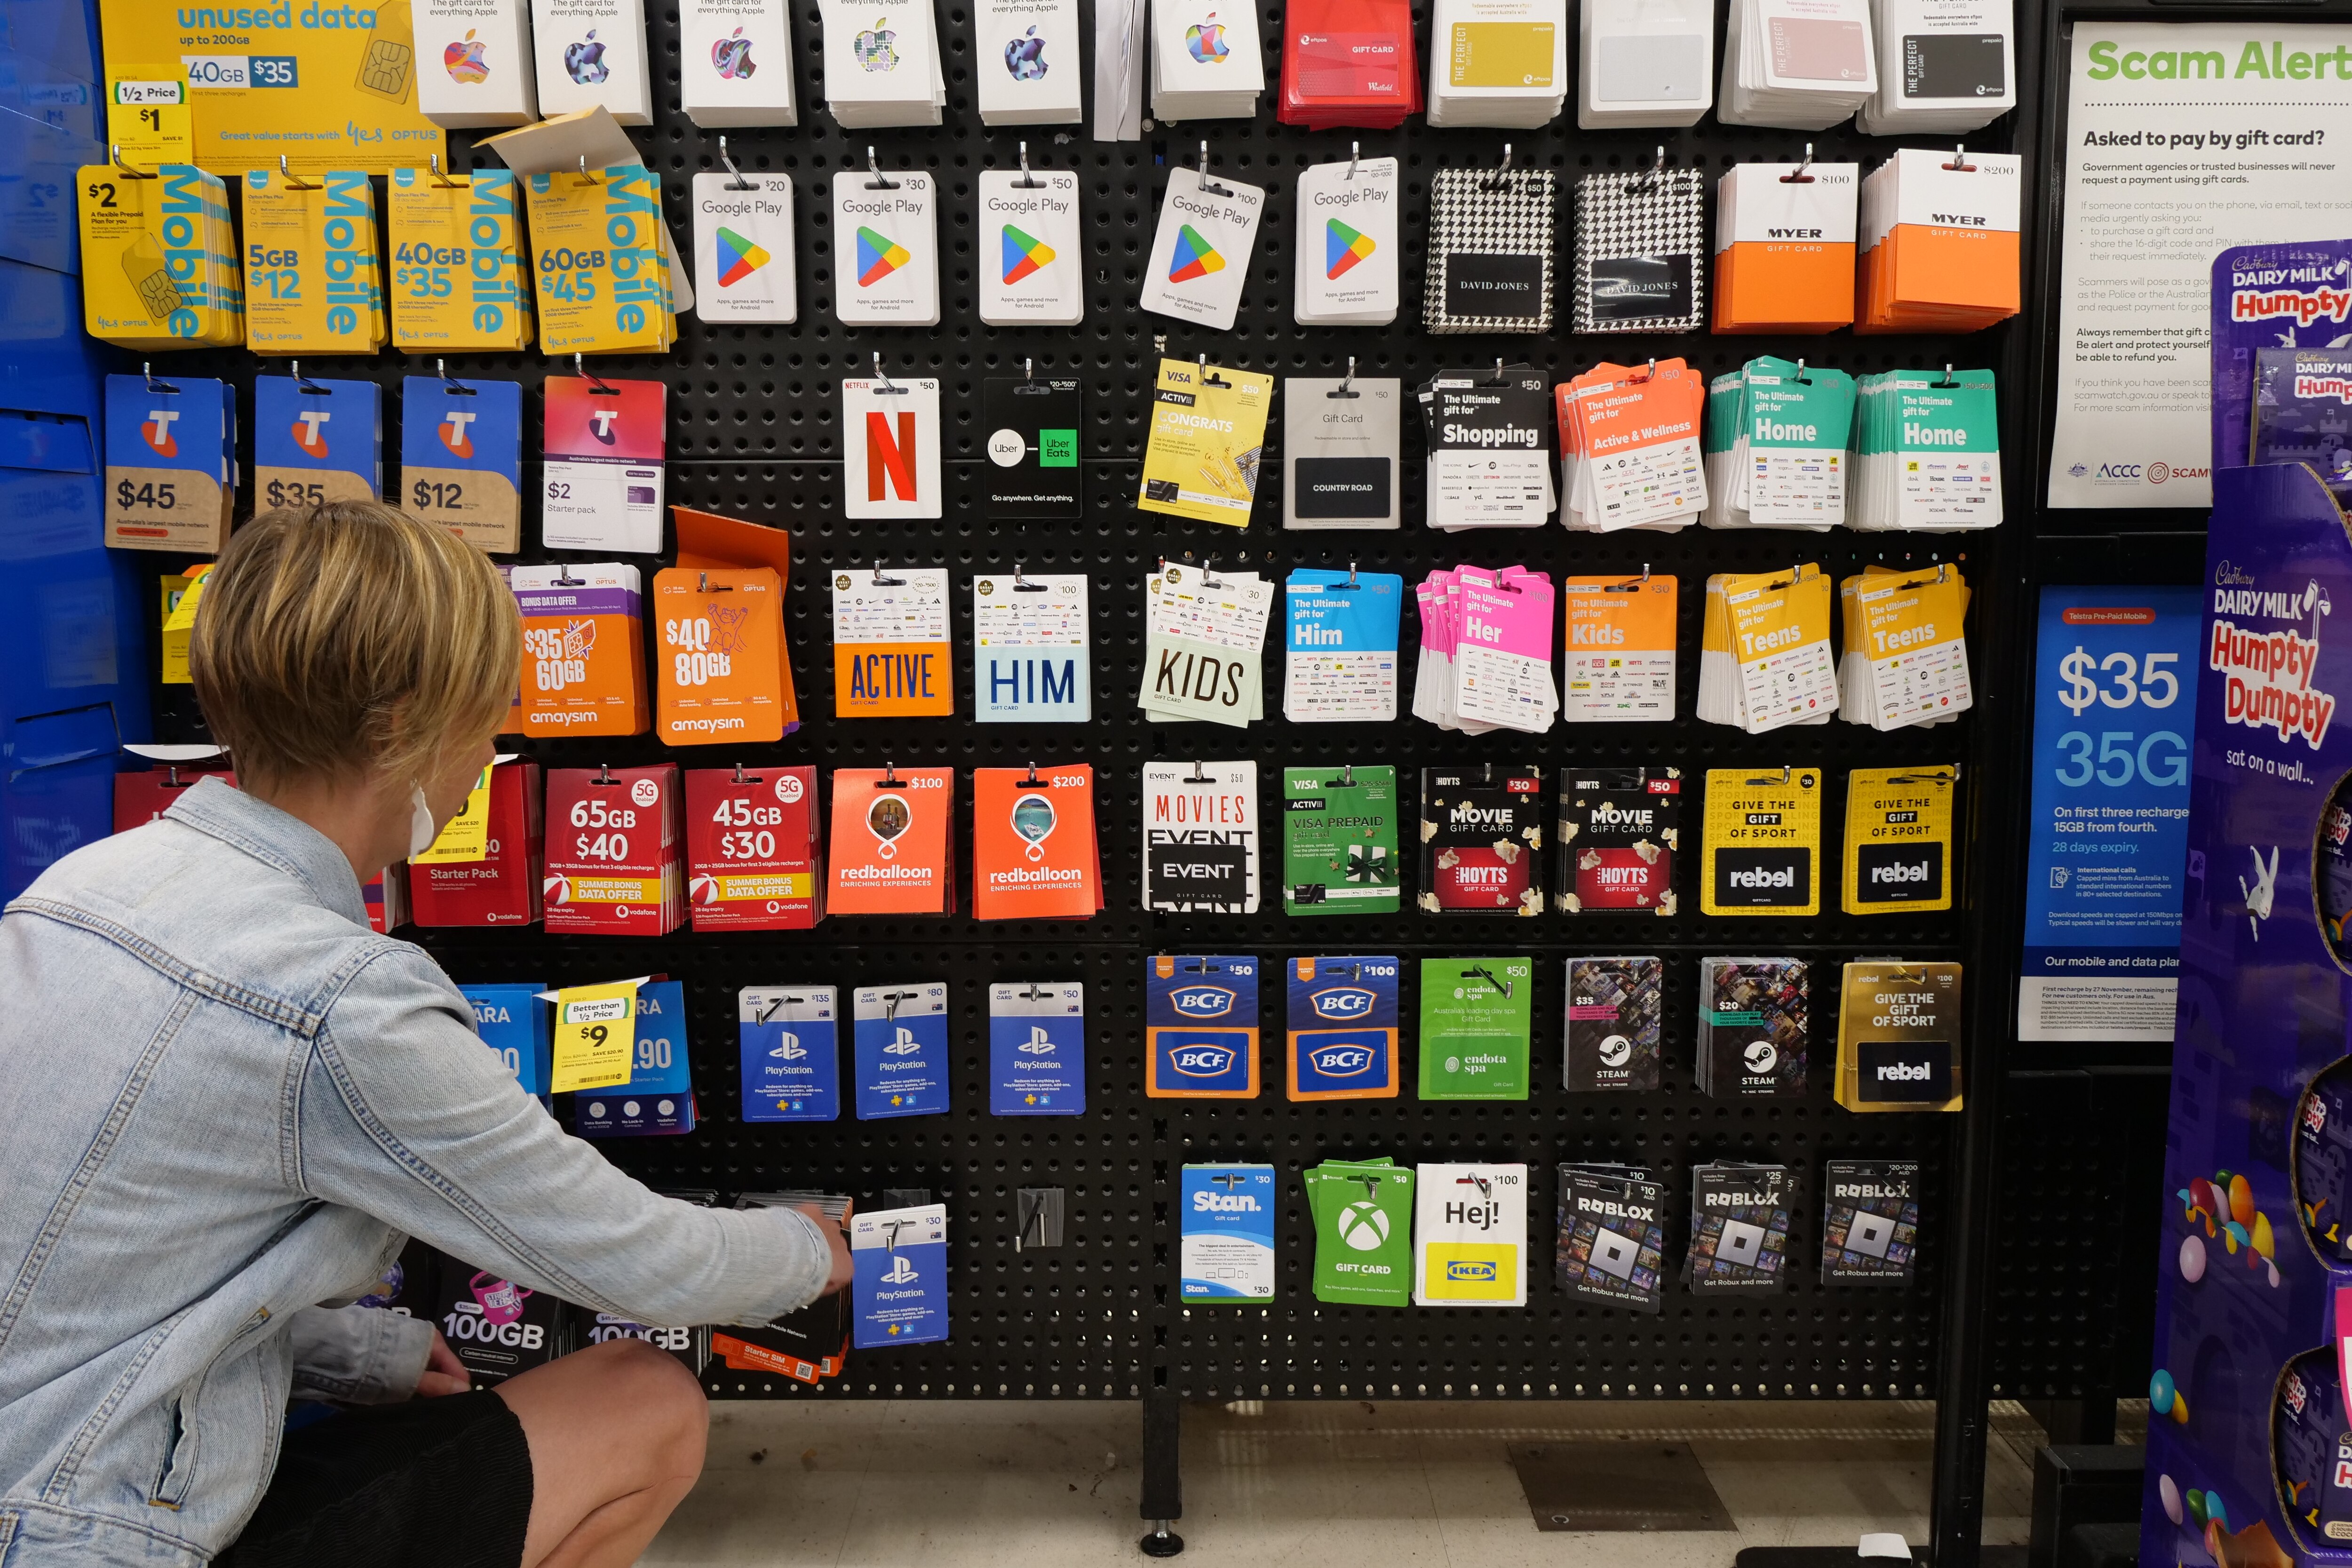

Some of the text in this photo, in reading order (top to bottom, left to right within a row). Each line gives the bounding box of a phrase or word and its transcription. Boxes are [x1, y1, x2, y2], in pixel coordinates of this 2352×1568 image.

[177, 0, 377, 29] unused data
[430, 7, 498, 17] everything Apple
[180, 35, 250, 46] up to 200GB
[1907, 40, 1918, 93] THE PERFECT
[2087, 41, 2352, 80] Scam Alert
[189, 61, 293, 83] 40GB $35
[147, 87, 175, 98] Price
[1367, 82, 1392, 92] Westfield
[140, 109, 160, 132] $1
[2084, 130, 2324, 150] Asked to pay by gift card?
[2145, 163, 2187, 173] agencies
[765, 181, 785, 191] $20
[1822, 175, 1849, 184] $100
[2082, 176, 2118, 185] request
[2129, 176, 2172, 185] payment
[2174, 176, 2200, 185] using
[2202, 175, 2218, 185] gift
[88, 183, 117, 208] $2
[702, 200, 782, 217] Google Play
[1768, 229, 1822, 238] MYER
[159, 166, 208, 339] Mobile
[249, 244, 298, 268] 5GB
[540, 250, 605, 272] 60GB
[250, 270, 300, 299] $12
[541, 272, 596, 302] $45
[1460, 281, 1529, 291] DAVID JONES
[2233, 268, 2335, 287] DAIRY MILK
[2236, 290, 2351, 322] Humpty
[1444, 395, 1500, 404] The Ultimate
[1444, 406, 1474, 416] gift for
[1443, 424, 1538, 447] Shopping
[1756, 418, 1816, 442] Home
[1046, 439, 1069, 448] Uber
[117, 478, 175, 511] $45
[548, 504, 596, 515] Starter pack
[2215, 589, 2303, 620] DAIRY MILK
[667, 618, 709, 652] $40
[1295, 623, 1342, 645] Him
[1467, 616, 1502, 643] Her
[2213, 625, 2315, 690] Humpty
[675, 652, 731, 685] 80GB
[850, 654, 934, 699] ACTIVE
[1155, 649, 1244, 707] KIDS
[991, 660, 1074, 704] HIM
[2058, 646, 2178, 716] $35
[2228, 677, 2331, 743] Dumpty
[672, 717, 744, 733] amaysim
[2056, 731, 2187, 787] 35G
[2227, 750, 2245, 766] sat
[2249, 756, 2264, 772] on
[2266, 761, 2274, 774] a
[636, 784, 654, 796] 5G
[912, 778, 943, 788] $100
[1510, 781, 1530, 790] $30
[571, 800, 636, 828] 65GB
[1156, 795, 1244, 823] MOVIES
[1732, 800, 1796, 810] GIVE THE
[2054, 806, 2133, 818] On first three
[1450, 809, 1513, 823] MOVIE
[1749, 814, 1777, 824] GIFT
[1731, 828, 1796, 838] OF SPORT
[2054, 822, 2157, 832] 15GB from fourth.
[576, 833, 628, 861] $40
[430, 868, 499, 879] Starter Pack
[841, 865, 931, 880] redballoon
[1163, 864, 1234, 879] EVENT
[1460, 867, 1507, 883] HOYTS
[1730, 867, 1793, 888] rebel
[1365, 966, 1395, 975] $100
[812, 995, 829, 1003] $135
[1321, 997, 1366, 1010] BCF
[1719, 1002, 1738, 1011] $20
[581, 1026, 608, 1047] $9
[1465, 1054, 1506, 1064] endota
[765, 1066, 813, 1075] PlayStation
[1465, 1064, 1486, 1075] spa
[1193, 1191, 1261, 1212] Stan.
[1578, 1197, 1653, 1222] ROBLOX
[1445, 1202, 1500, 1230] Hej!
[1452, 1266, 1492, 1276] IKEA
[1592, 1287, 1613, 1296] Robux
[443, 1312, 544, 1350] 100GB
[745, 1345, 771, 1360] Starter
[771, 1355, 785, 1364] SIM
